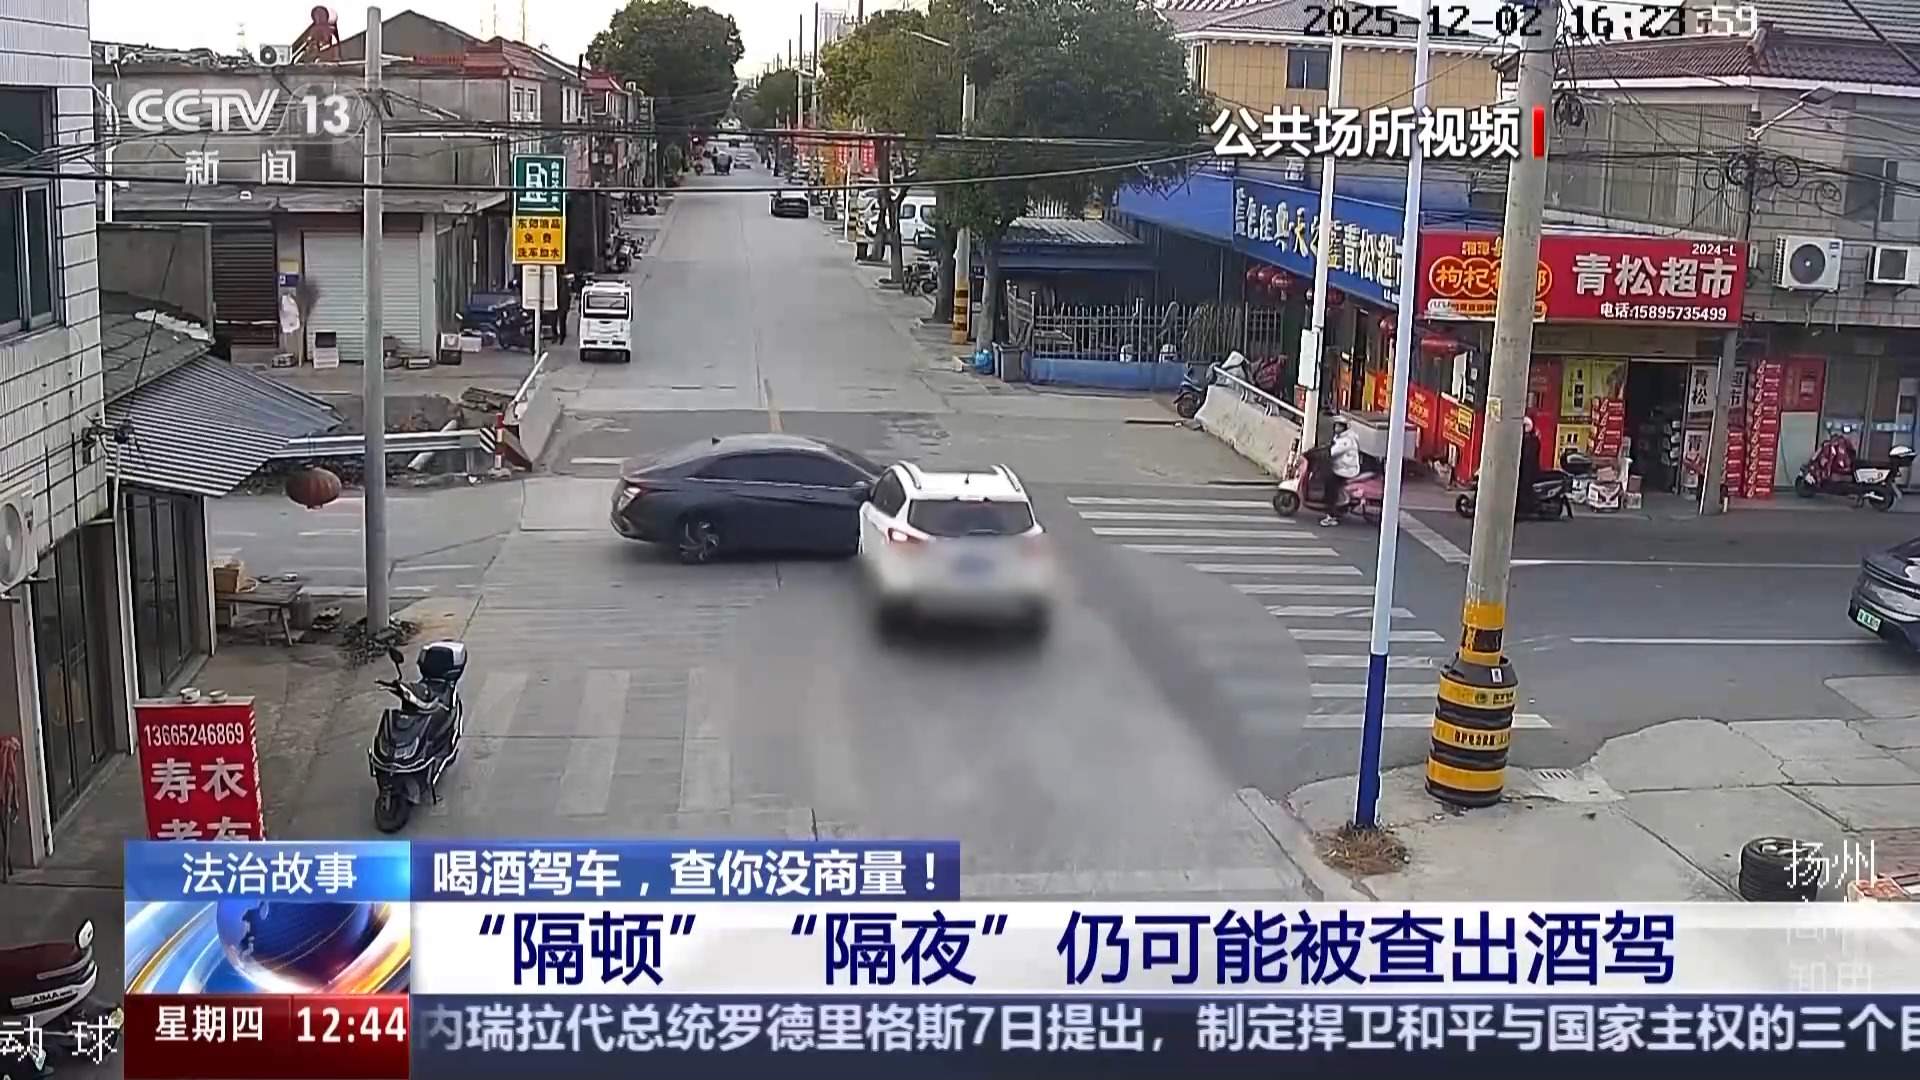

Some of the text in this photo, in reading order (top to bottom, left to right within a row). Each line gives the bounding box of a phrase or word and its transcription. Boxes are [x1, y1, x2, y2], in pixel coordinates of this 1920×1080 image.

[1572, 253, 1737, 299] 青松超市
[144, 724, 245, 747] 13665246869
[150, 757, 248, 803] 寿衣
